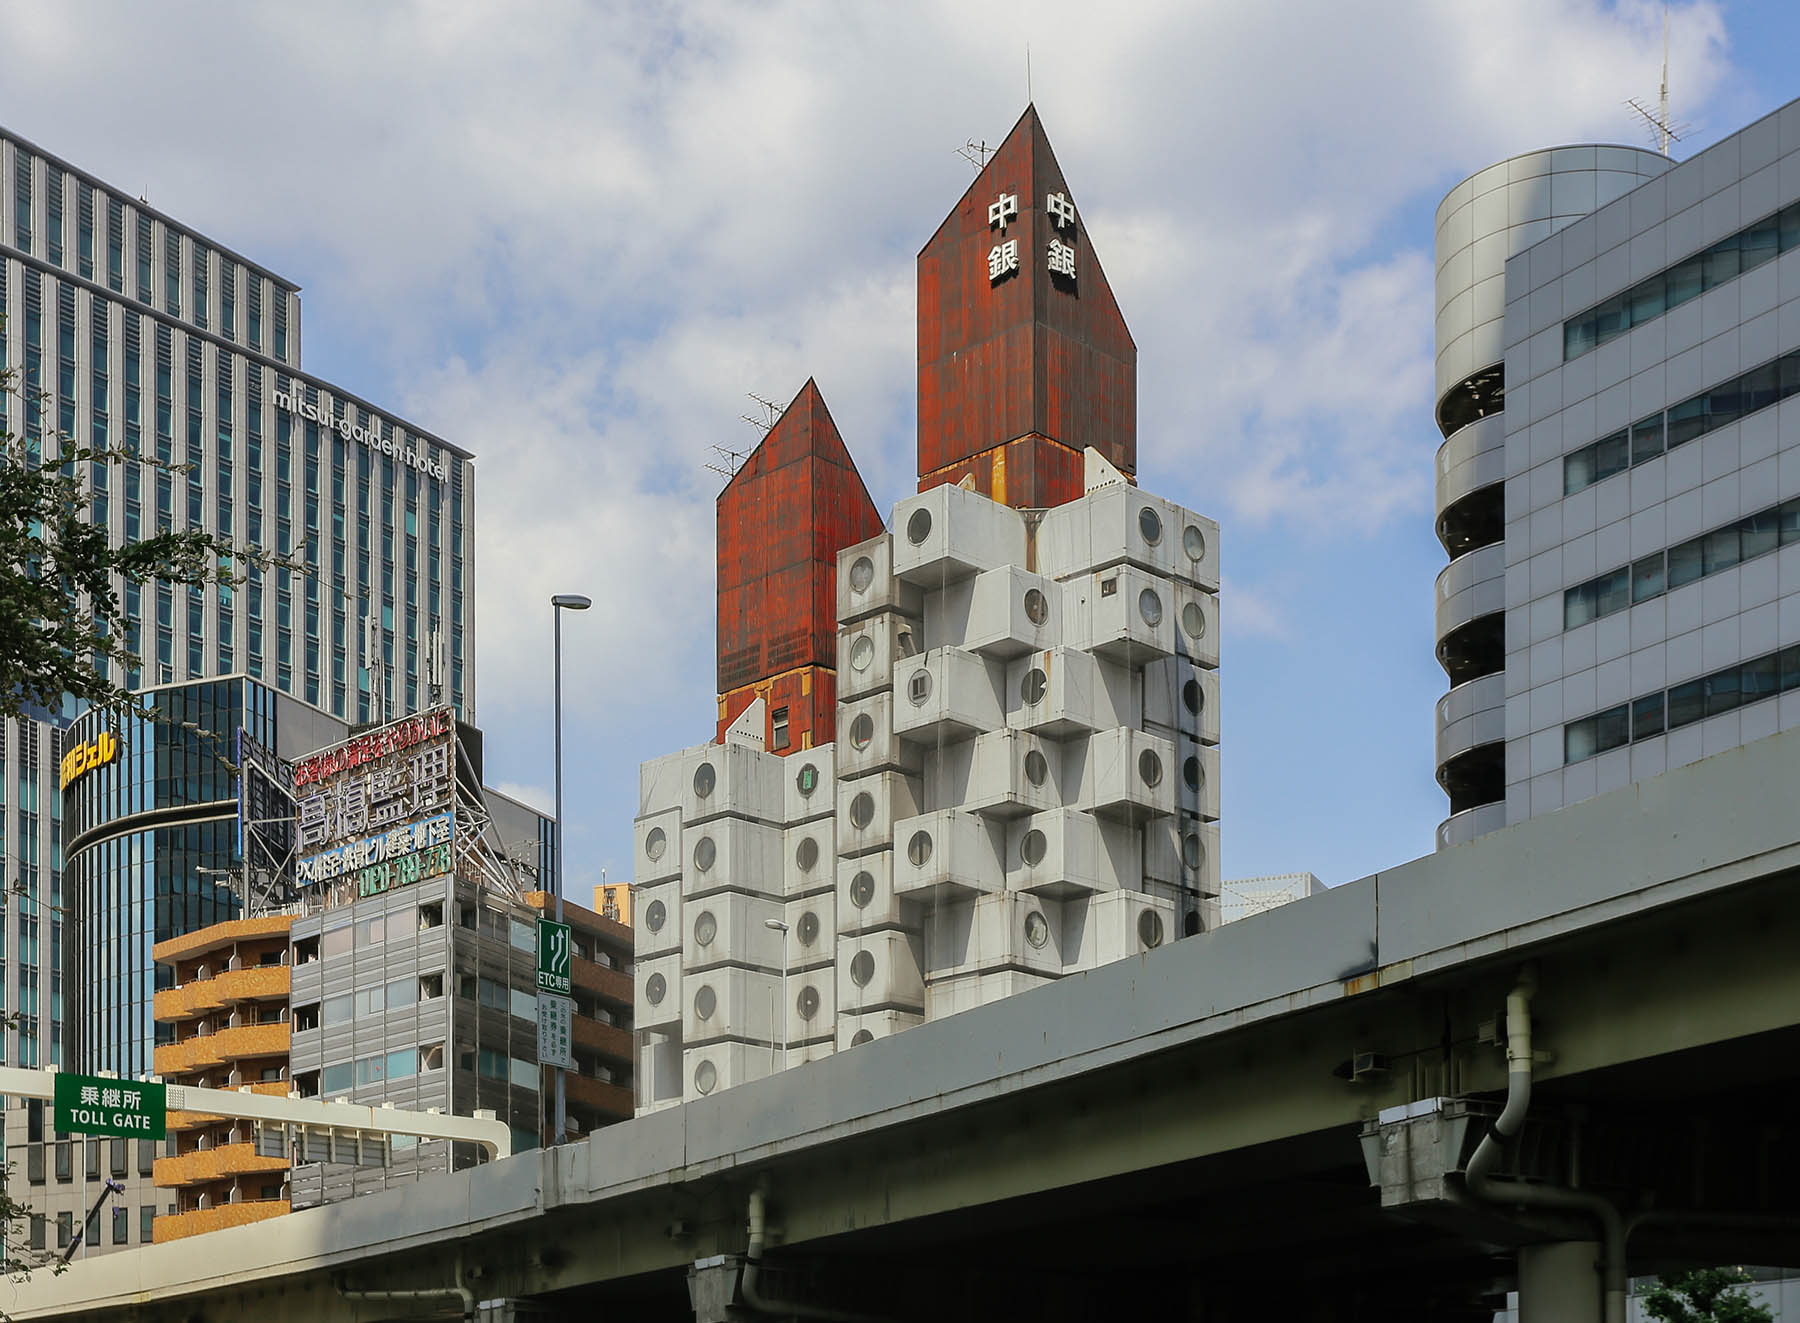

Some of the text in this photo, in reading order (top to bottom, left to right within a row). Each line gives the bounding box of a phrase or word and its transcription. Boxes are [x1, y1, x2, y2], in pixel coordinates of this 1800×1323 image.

[987, 193, 1019, 280] 中銀
[1047, 192, 1076, 280] 中銀
[273, 384, 448, 483] mitsui garden hotel
[70, 1109, 151, 1130] TOLL GATE
[80, 1086, 141, 1110] 乗継所
